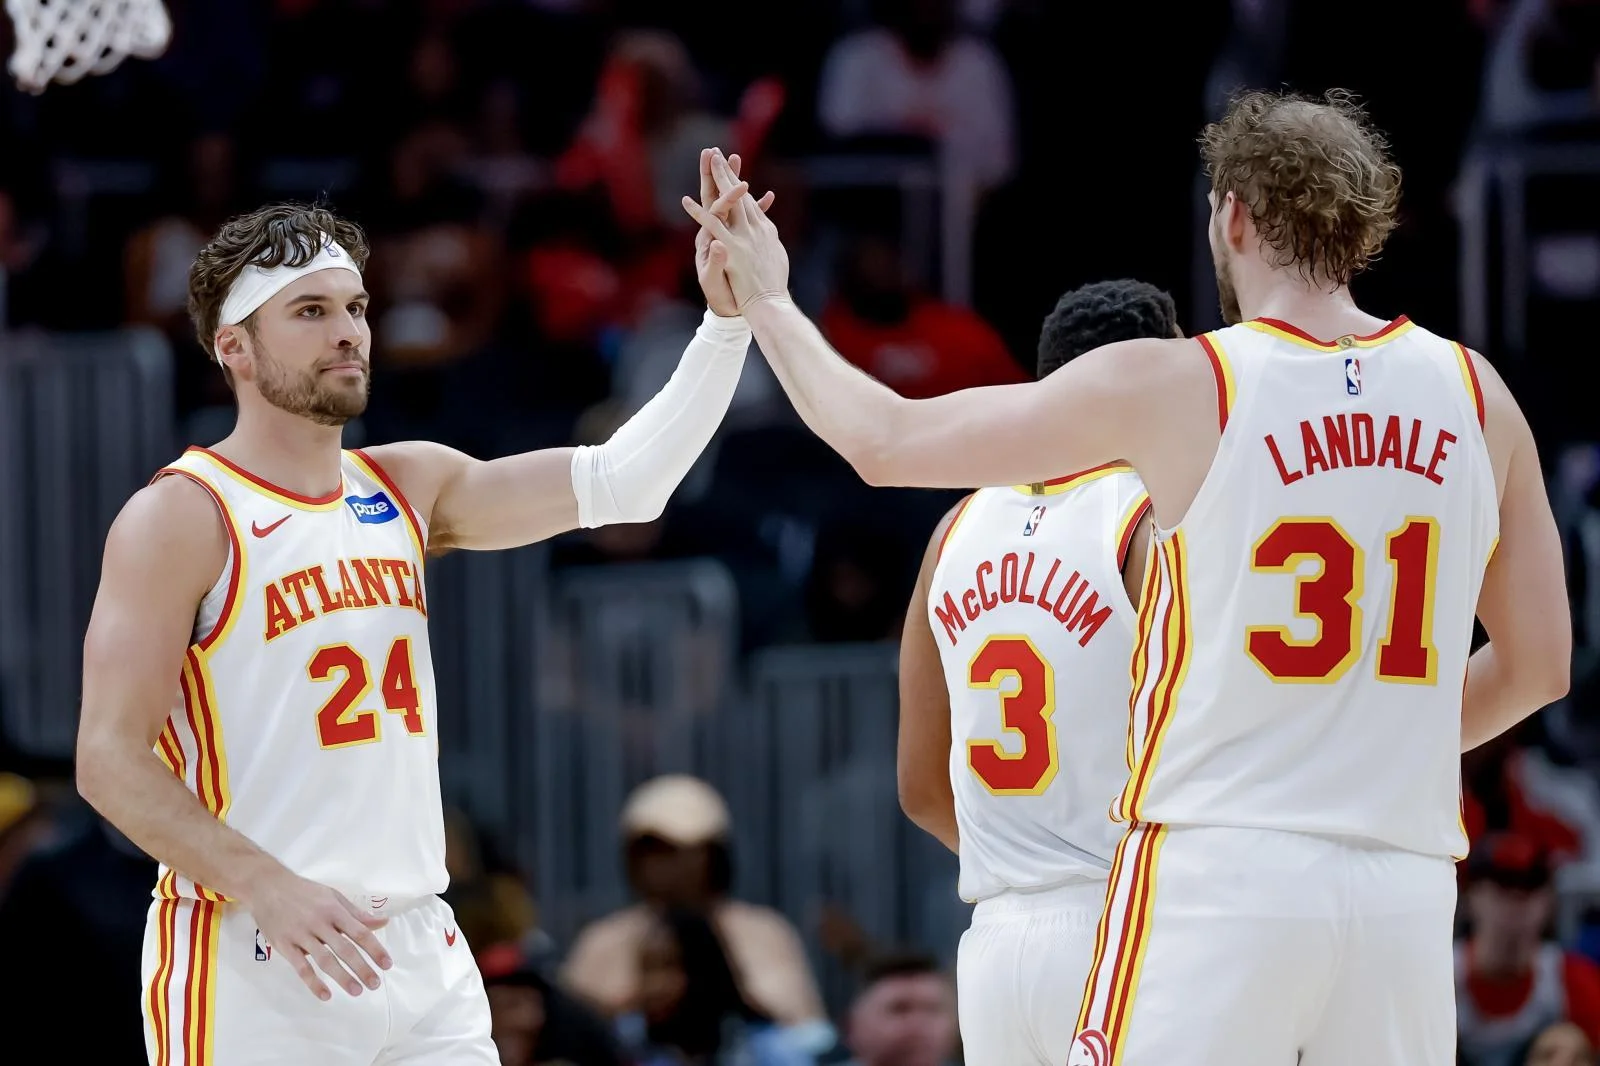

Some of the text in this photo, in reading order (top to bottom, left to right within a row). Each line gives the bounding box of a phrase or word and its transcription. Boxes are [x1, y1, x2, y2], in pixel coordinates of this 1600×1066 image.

[1264, 413, 1457, 486] LANDALE
[264, 557, 427, 643] ATLANTA
[935, 551, 1112, 648] McCOLLUM
[1245, 516, 1441, 685] 31
[306, 635, 427, 750] 24
[966, 634, 1060, 796] 3
